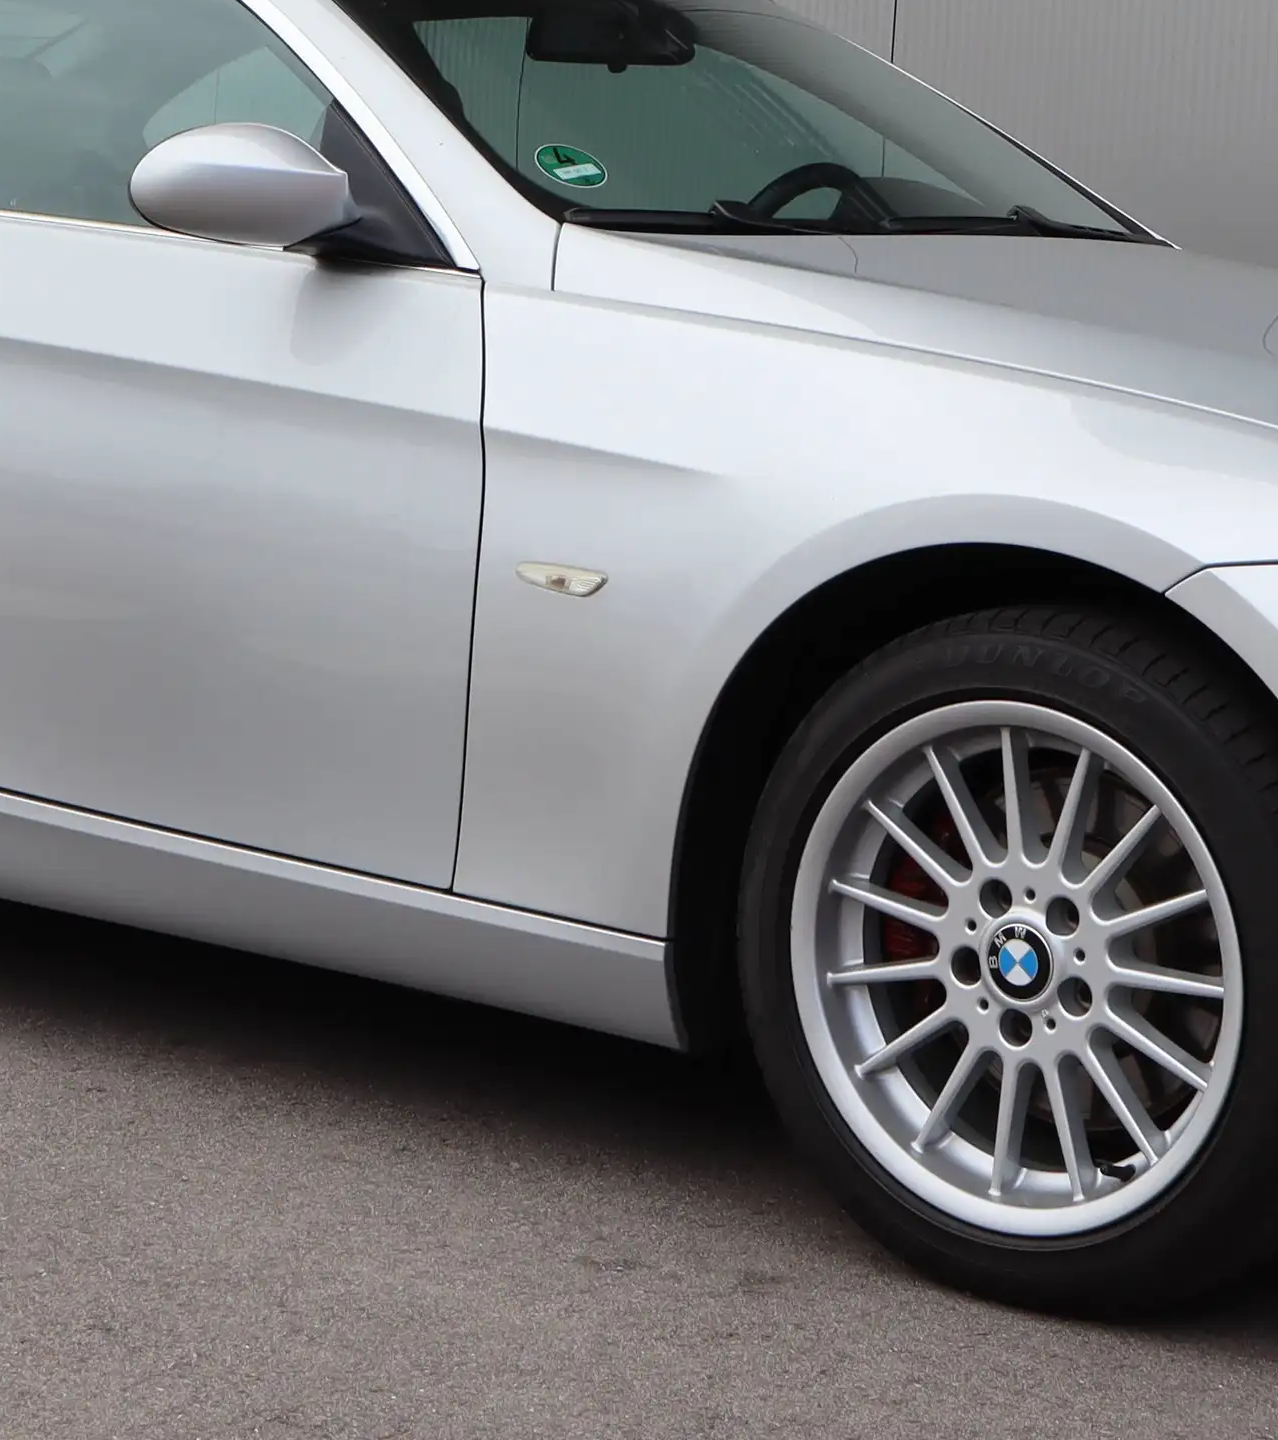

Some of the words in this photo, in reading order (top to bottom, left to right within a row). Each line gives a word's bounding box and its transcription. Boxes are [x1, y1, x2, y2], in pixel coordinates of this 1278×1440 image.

[552, 147, 576, 165] 4
[945, 643, 1147, 704] DUNLOP
[988, 925, 1027, 969] BMW
